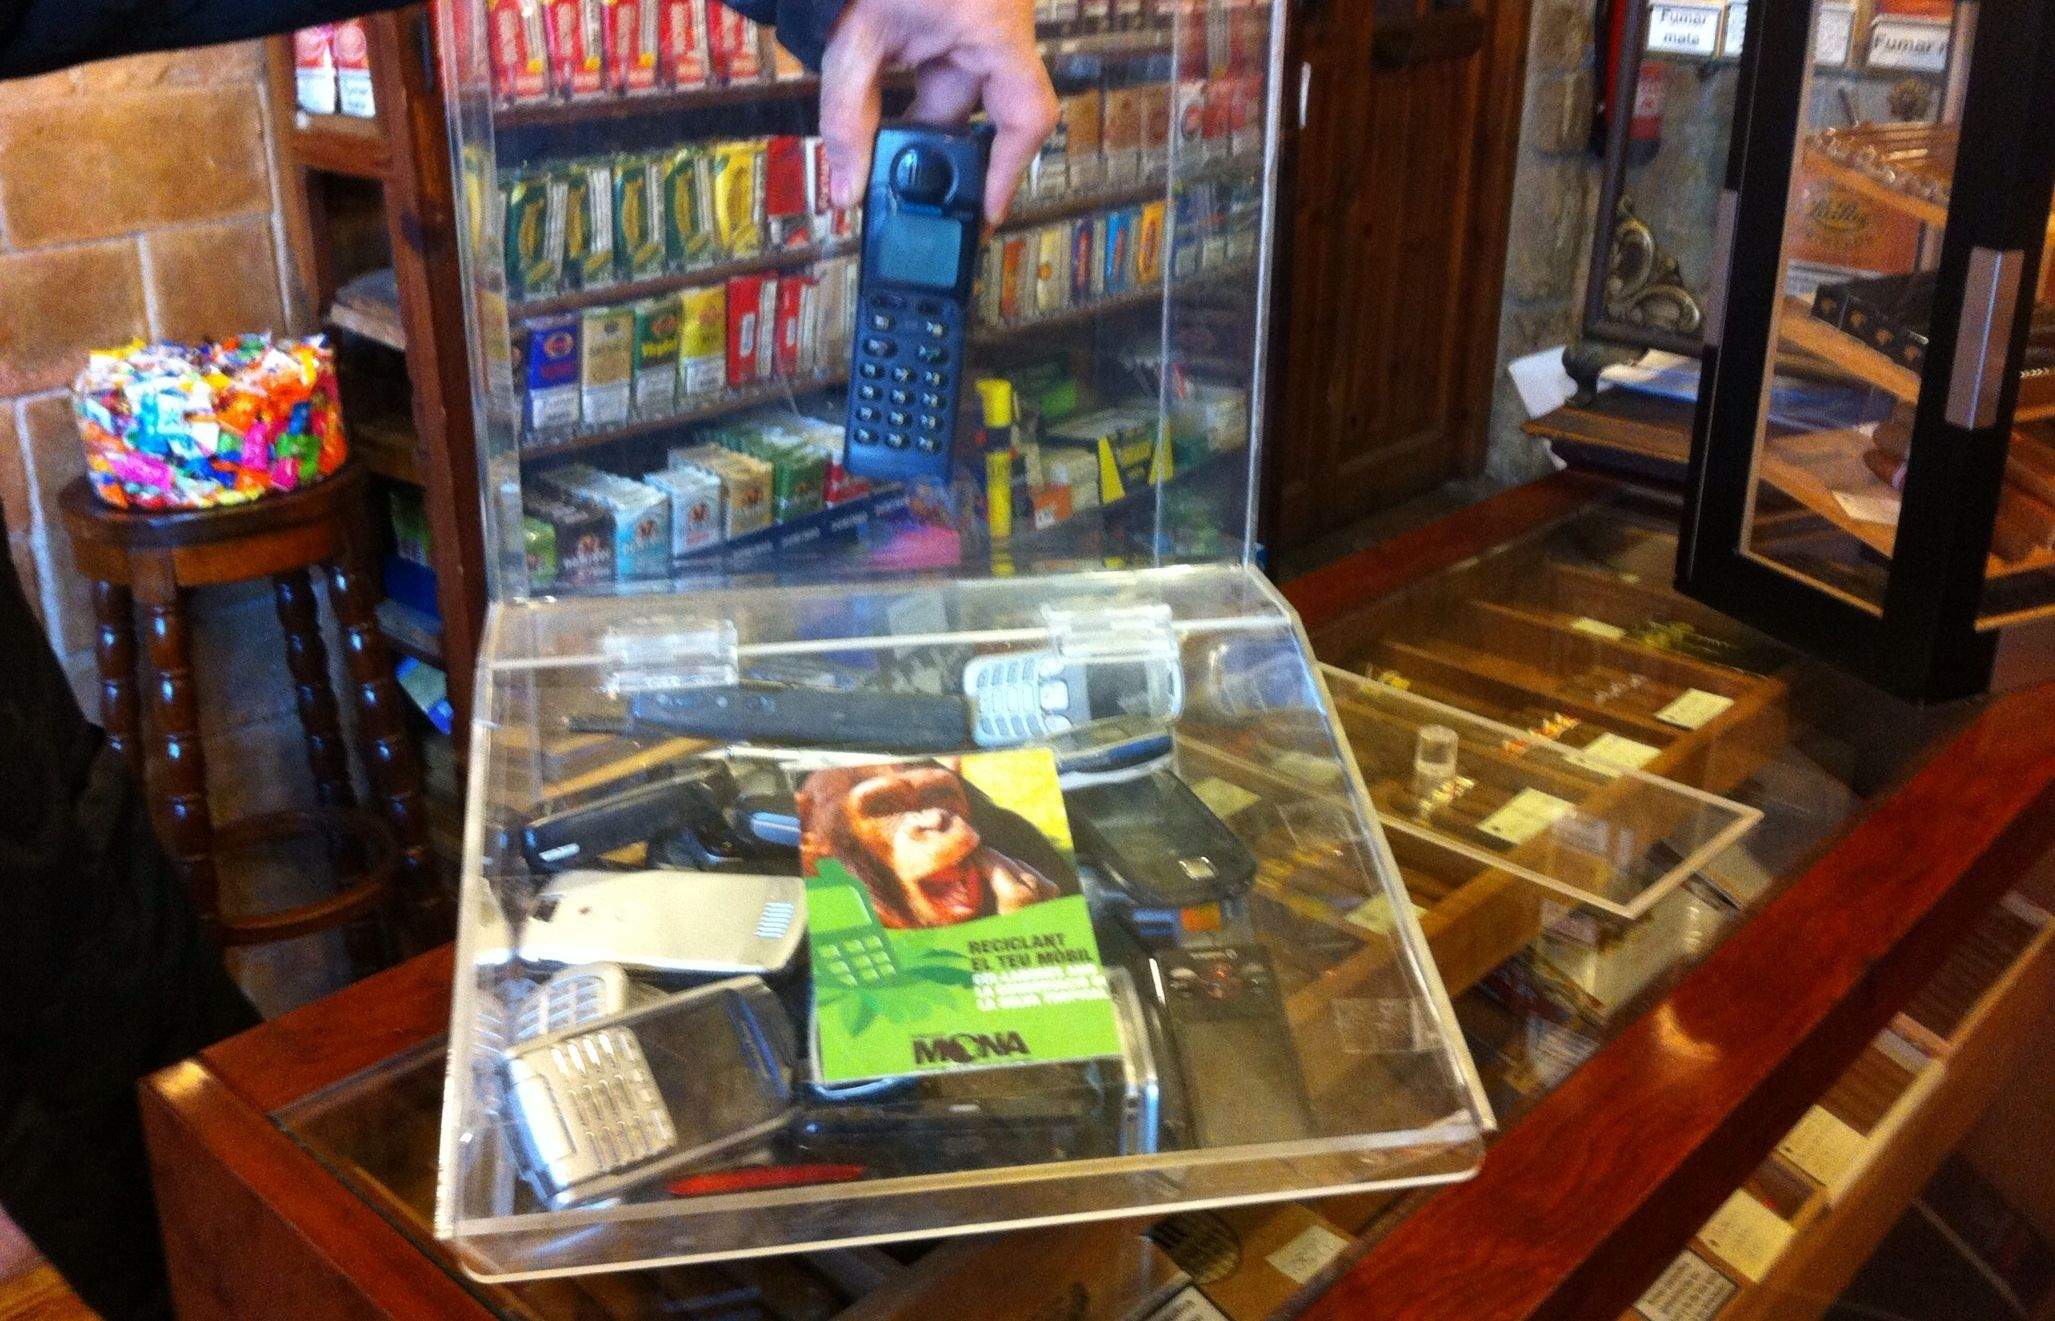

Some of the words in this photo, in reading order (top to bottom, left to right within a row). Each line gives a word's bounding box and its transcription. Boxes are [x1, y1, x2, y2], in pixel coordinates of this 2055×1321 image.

[968, 932, 1066, 954] RECICLANT
[971, 956, 991, 971] EL
[997, 952, 1032, 968] TEU
[913, 1030, 1031, 1065] MONA
